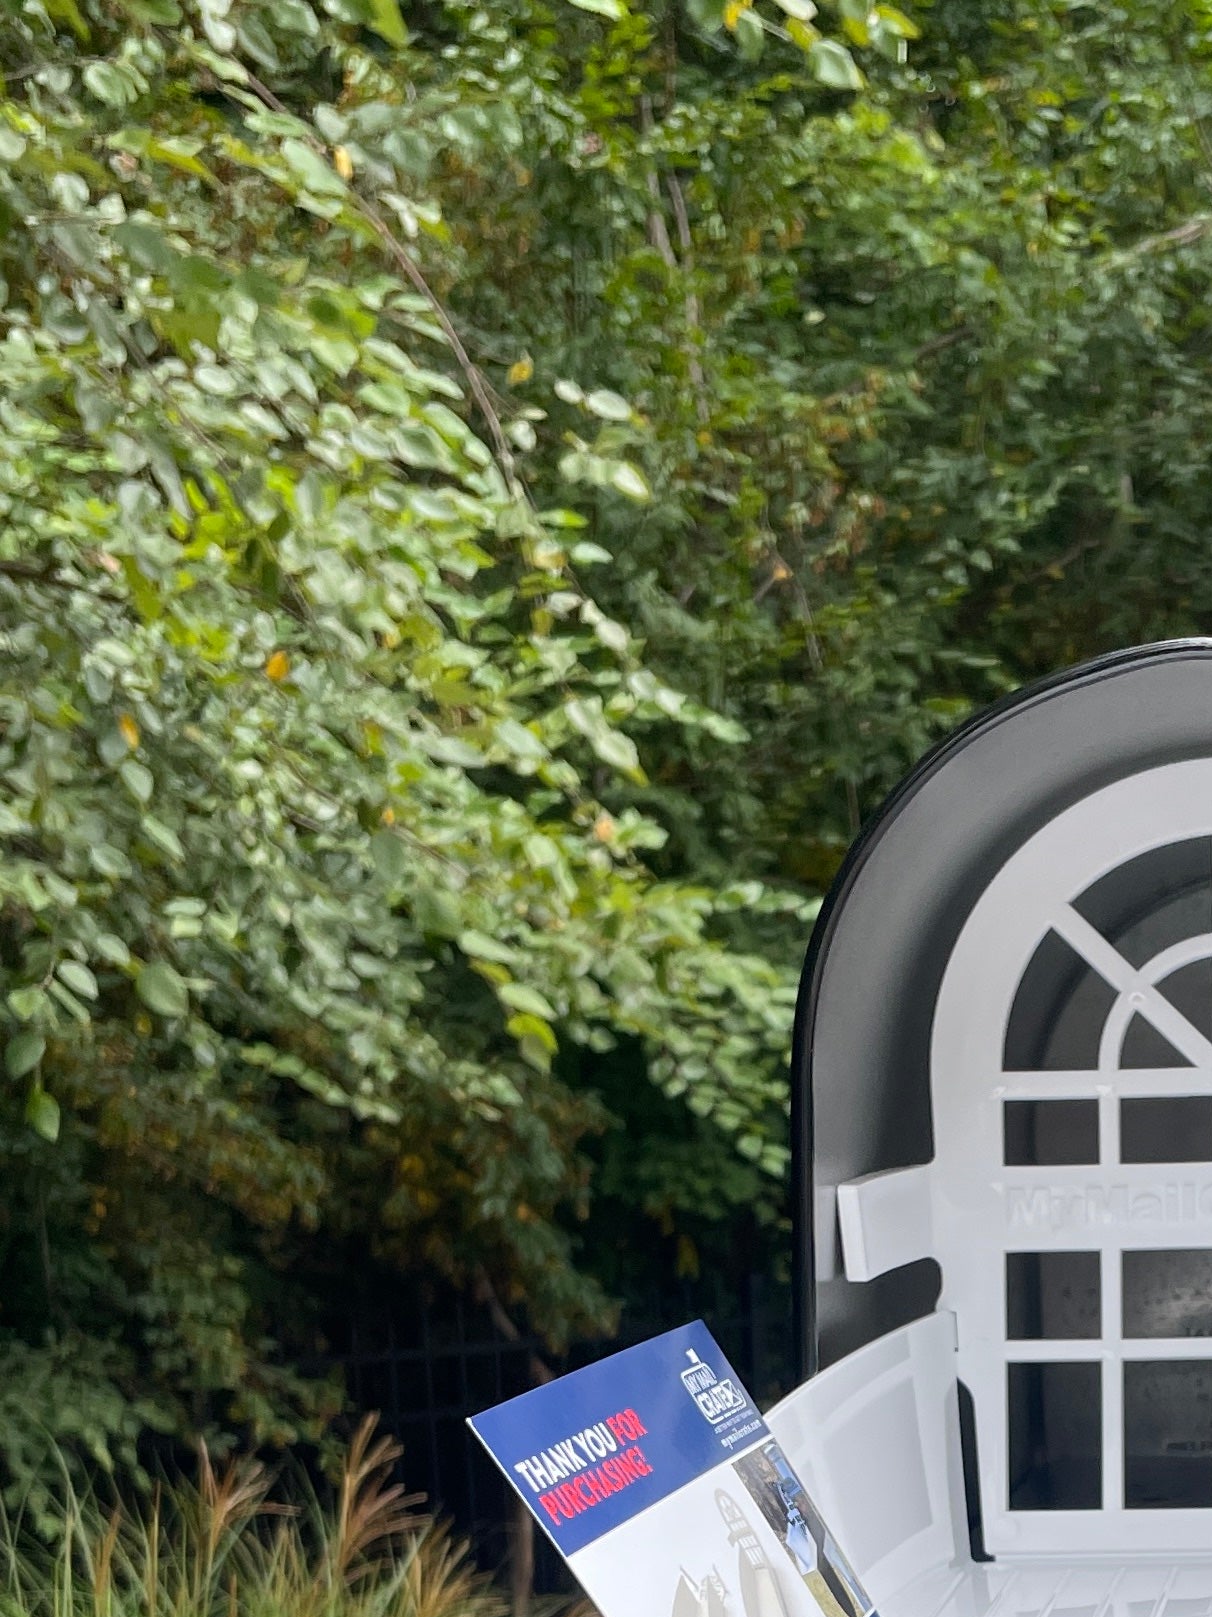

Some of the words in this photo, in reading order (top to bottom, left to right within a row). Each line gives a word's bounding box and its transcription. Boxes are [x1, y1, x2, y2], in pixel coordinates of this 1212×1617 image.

[684, 1374, 702, 1394] MY
[697, 1384, 733, 1418] CRATE
[513, 1438, 587, 1493] THANK
[572, 1422, 618, 1462] YOU
[606, 1408, 648, 1446] FOR
[538, 1446, 653, 1526] PURCHASING!
